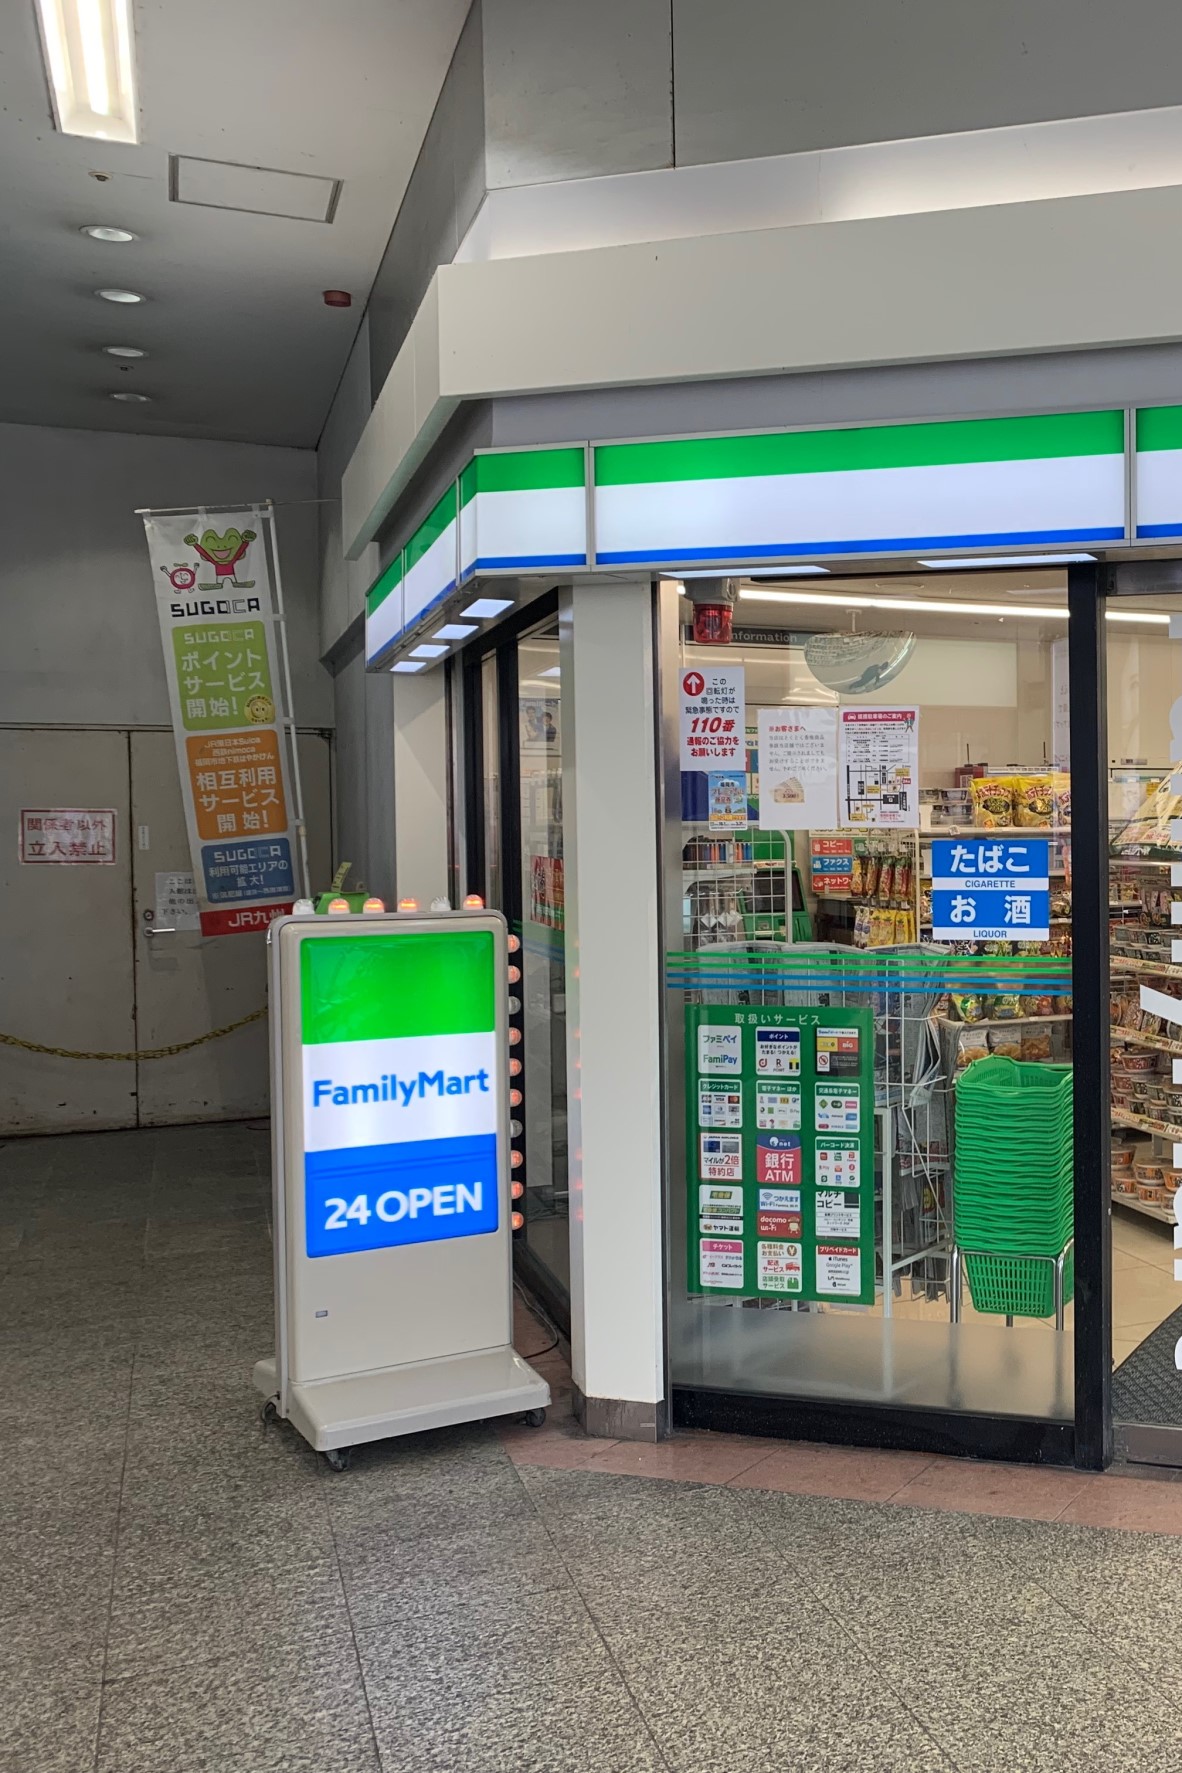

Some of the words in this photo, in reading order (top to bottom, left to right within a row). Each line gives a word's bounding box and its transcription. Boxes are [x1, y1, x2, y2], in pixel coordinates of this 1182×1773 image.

[170, 597, 260, 618] SUGOCA
[184, 628, 255, 645] SUGOCA
[729, 630, 798, 643] nformation
[181, 648, 261, 672] ポイント
[183, 671, 265, 695] サービス
[711, 678, 727, 686] この
[705, 687, 736, 696] 回転灯が
[691, 716, 736, 733] 110番
[686, 736, 740, 746] 通報のご協力を
[690, 747, 736, 757] お願いします
[196, 766, 277, 791] 相互利用
[199, 788, 279, 812] サービス
[27, 818, 107, 831] 関係者以外
[27, 841, 107, 856] 立入禁止
[822, 840, 844, 848] コピー
[822, 858, 850, 866] ファクス
[950, 844, 1030, 873] たばこ
[208, 860, 288, 878] 利用可能エリアの
[964, 880, 1016, 888] CIGARETTE
[973, 929, 1008, 938] LIQUOR
[734, 1013, 821, 1025] 取扱いサービス
[703, 1034, 738, 1044] ファミペイ
[703, 1054, 738, 1065] FamiPay
[312, 1067, 490, 1107] FamilyMart
[703, 1154, 740, 1165] マイルが2倍
[765, 1152, 795, 1169] 銀行
[708, 1167, 735, 1177] 特約店
[765, 1170, 794, 1182] ATM
[324, 1194, 372, 1230] 24
[375, 1181, 483, 1223] OPEN
[817, 1200, 842, 1209] コピー
[713, 1243, 733, 1251] チケット
